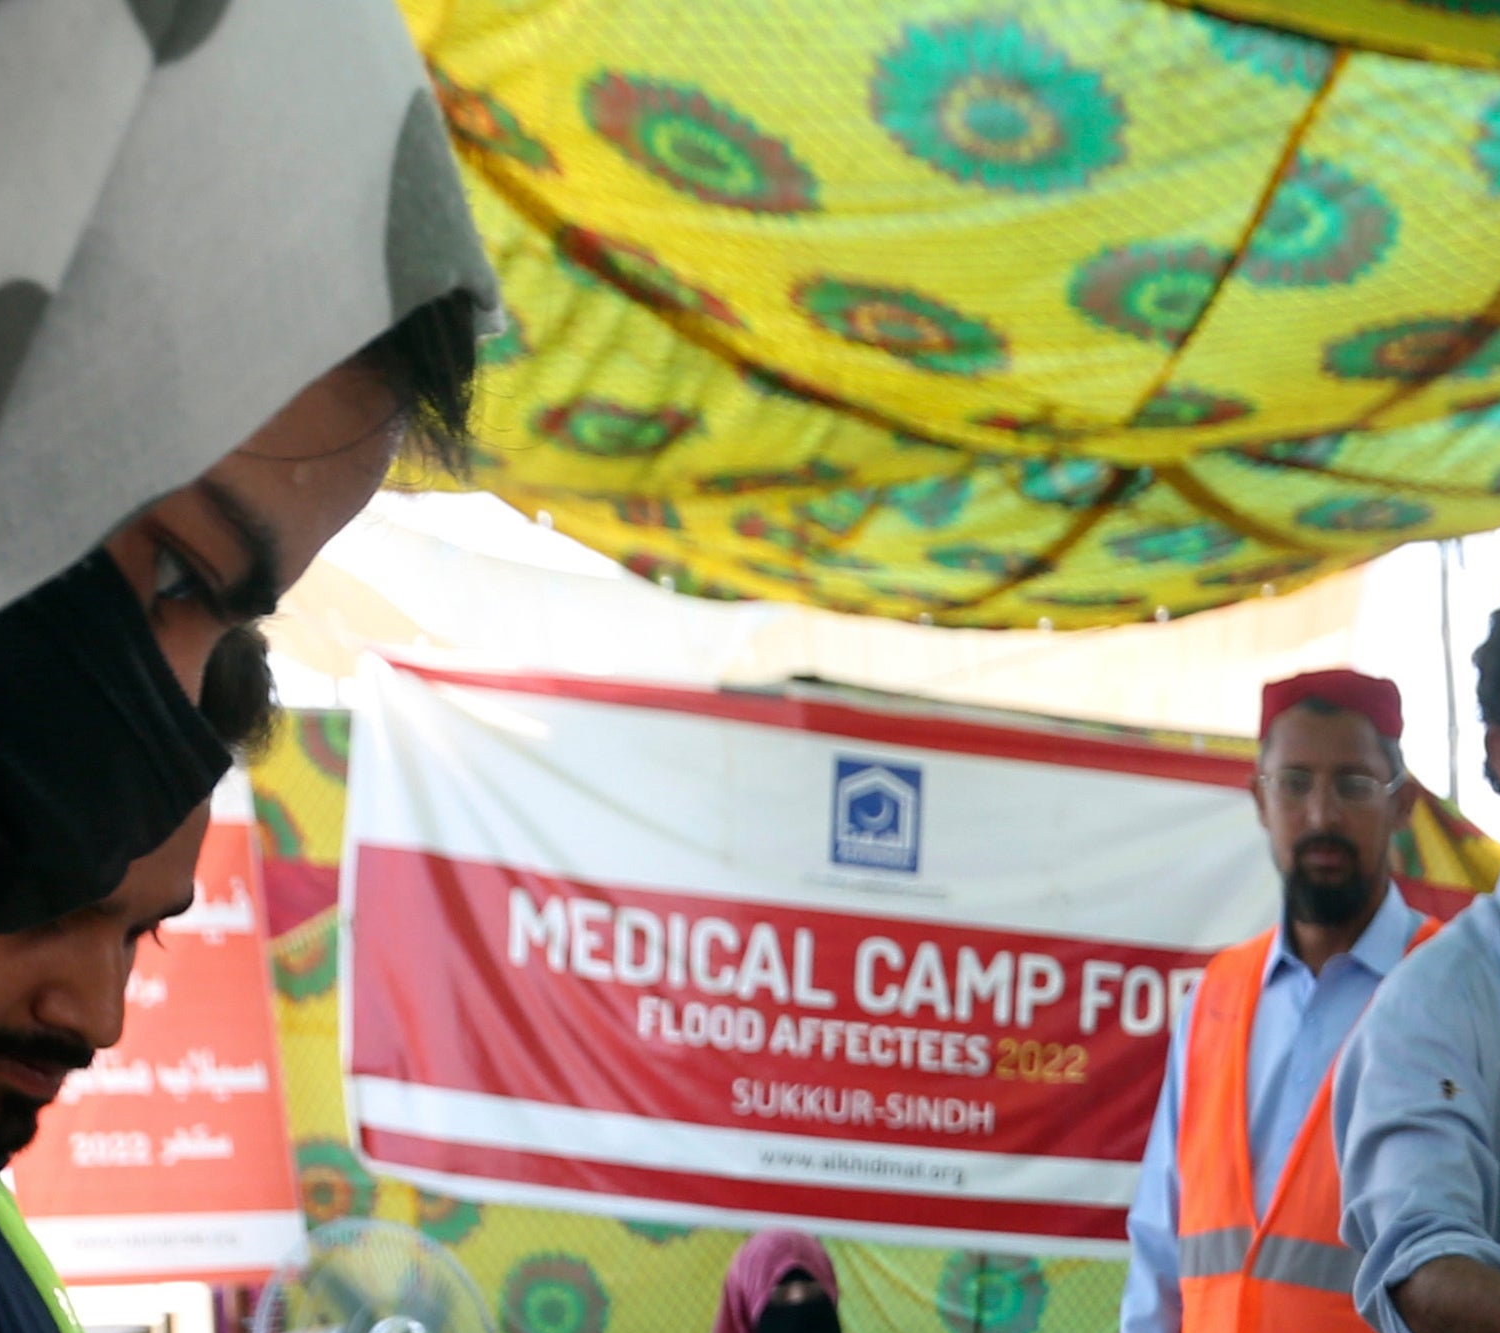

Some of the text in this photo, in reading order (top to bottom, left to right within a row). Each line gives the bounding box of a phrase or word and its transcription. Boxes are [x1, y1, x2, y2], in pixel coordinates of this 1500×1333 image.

[506, 886, 836, 1008] MEDICAL
[853, 935, 1065, 1028] CAMP
[636, 995, 1089, 1084] FLOOD AFFECTEES 2022
[731, 1076, 996, 1135] SUKKUR-SINDH
